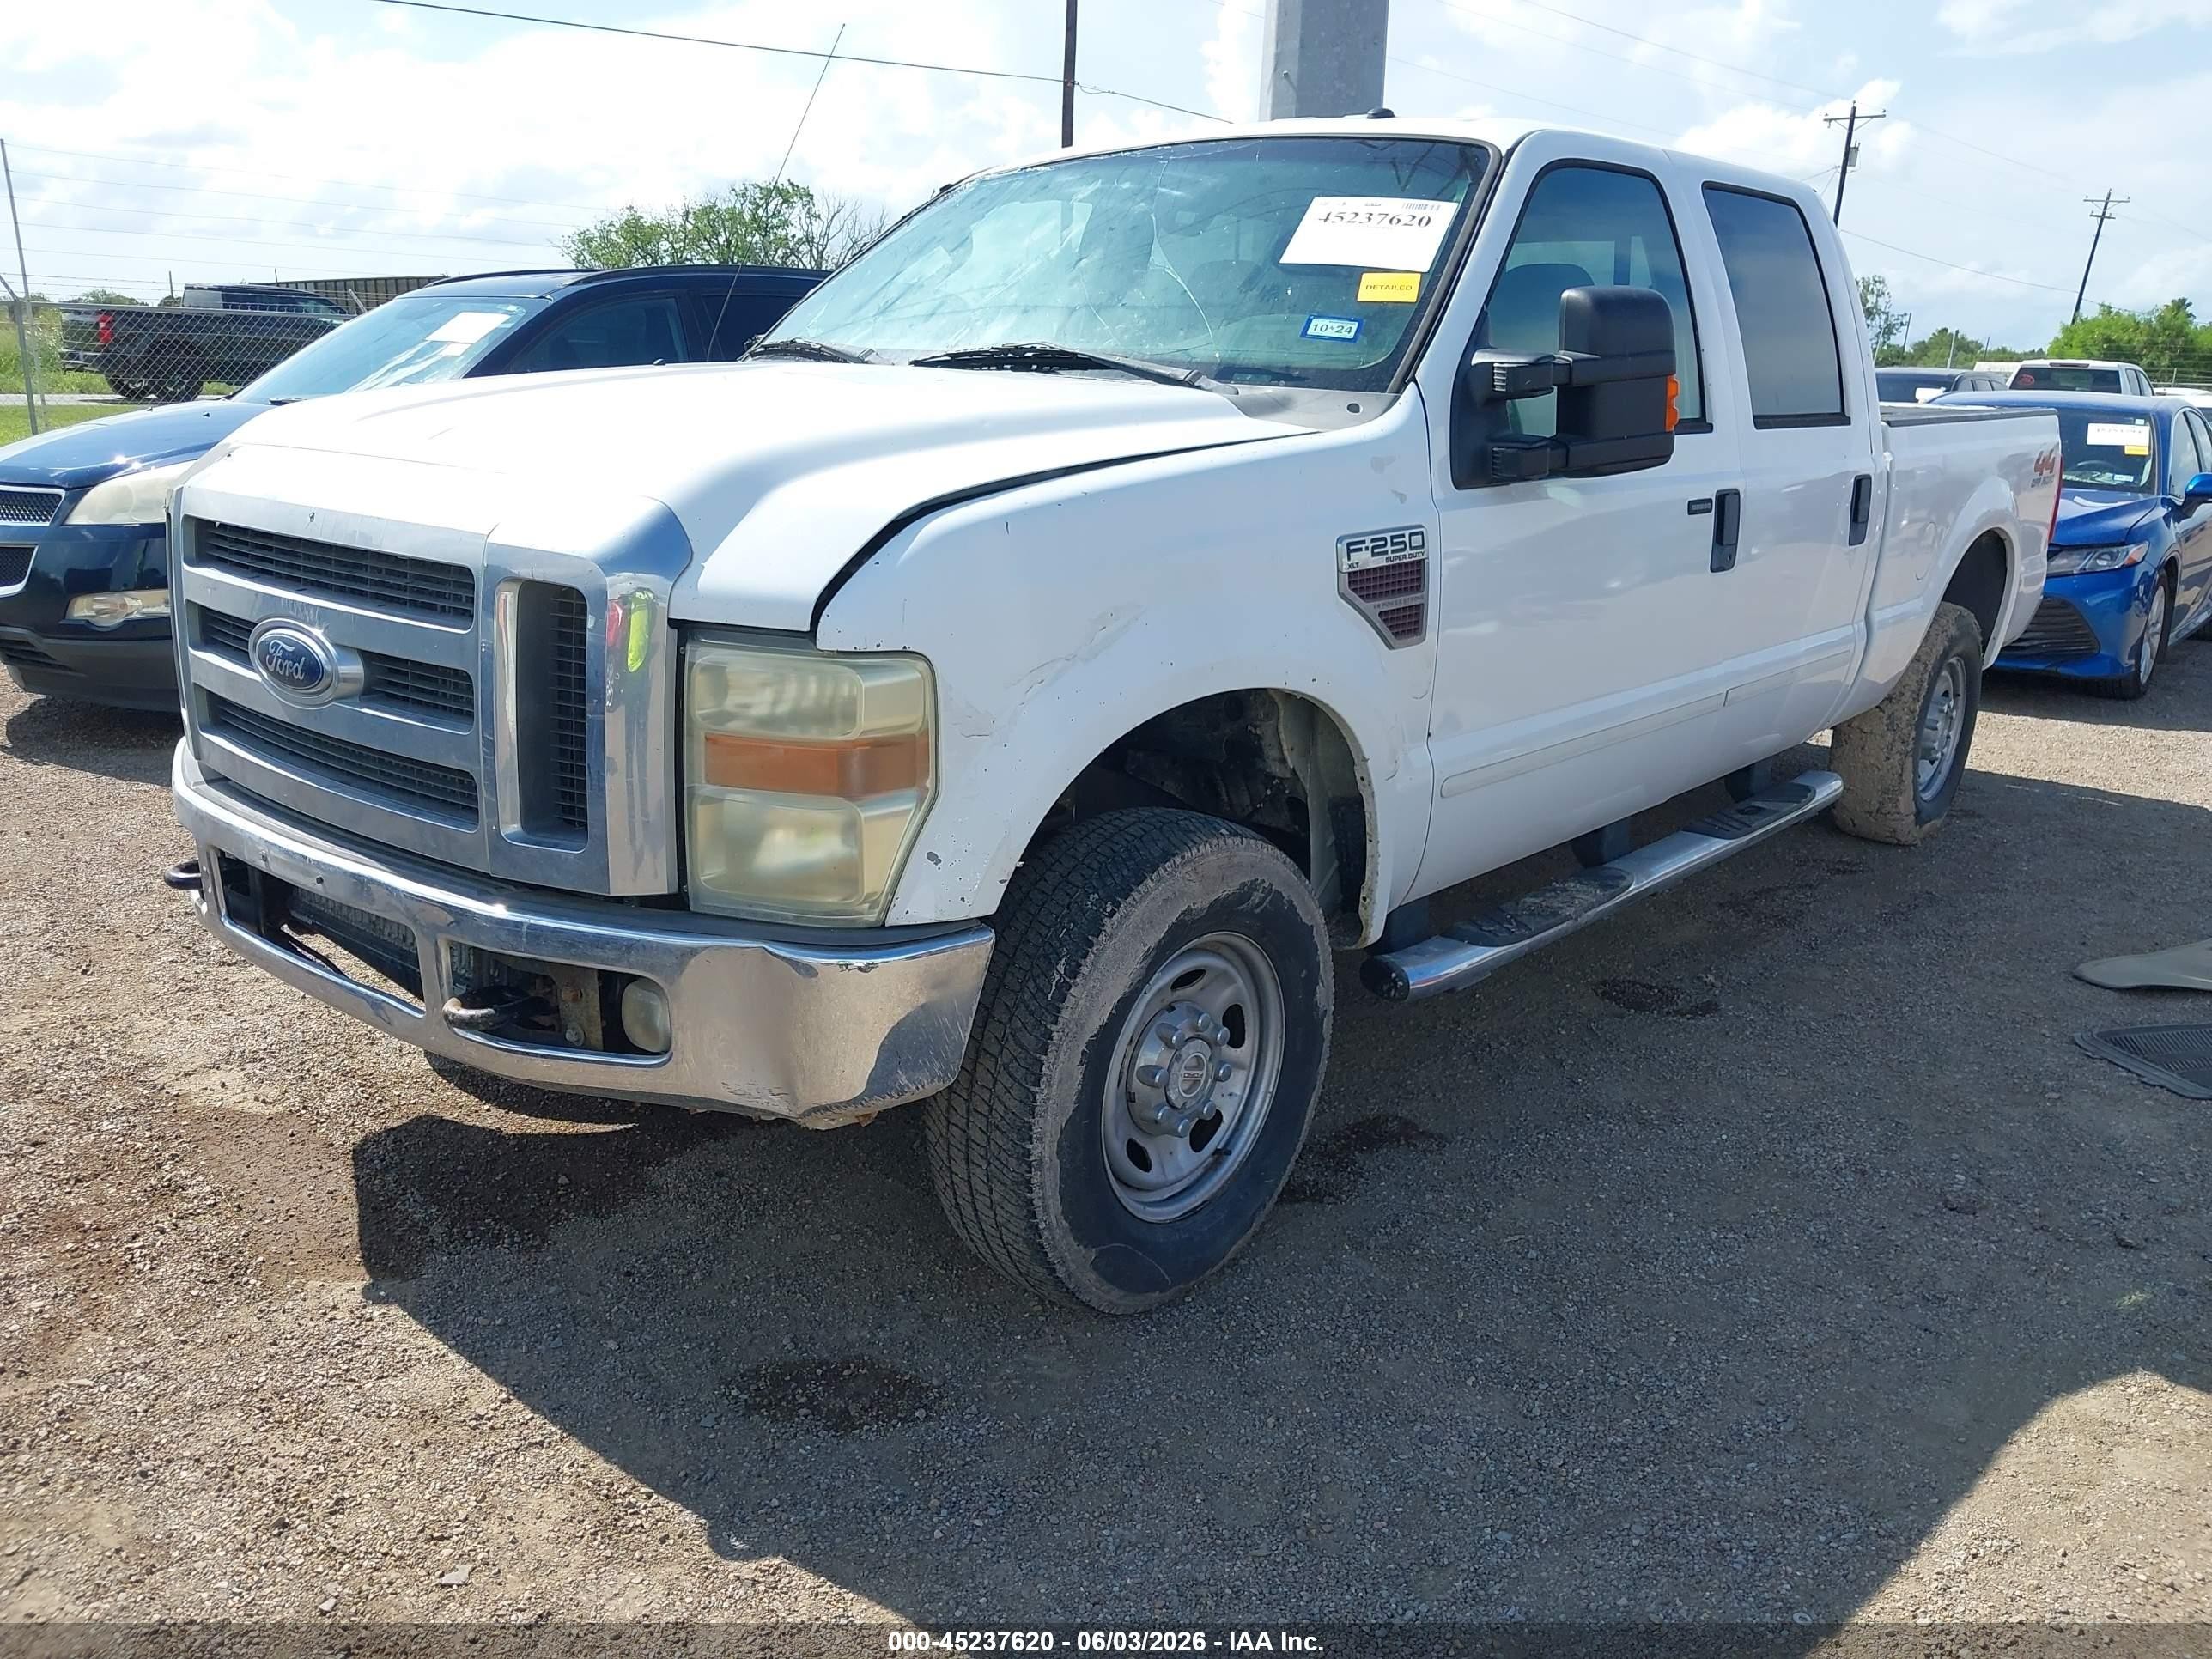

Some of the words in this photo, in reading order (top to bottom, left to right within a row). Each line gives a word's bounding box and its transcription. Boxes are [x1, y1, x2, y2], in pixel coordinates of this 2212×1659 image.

[1318, 211, 1432, 228] 45237620
[1346, 530, 1425, 562] F-250
[1346, 561, 1360, 570] XLT
[1385, 554, 1407, 564] SUPER
[1407, 550, 1426, 561] DUTY
[265, 638, 307, 681] Ford
